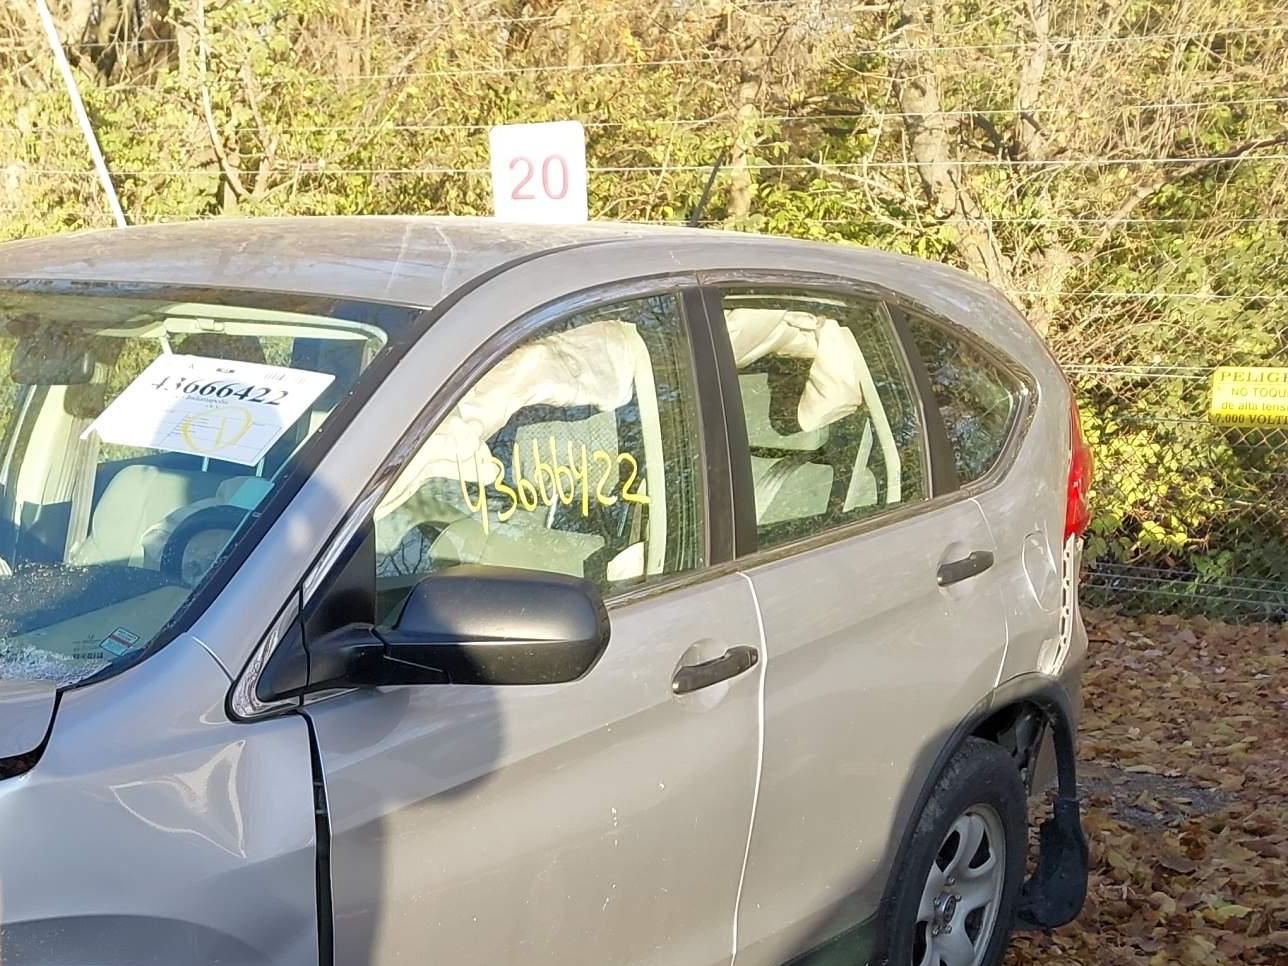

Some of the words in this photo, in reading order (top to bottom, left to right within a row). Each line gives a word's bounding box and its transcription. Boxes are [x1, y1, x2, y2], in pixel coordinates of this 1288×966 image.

[508, 153, 570, 201] 20
[1231, 387, 1249, 397] NO
[456, 436, 650, 535] 43666422
